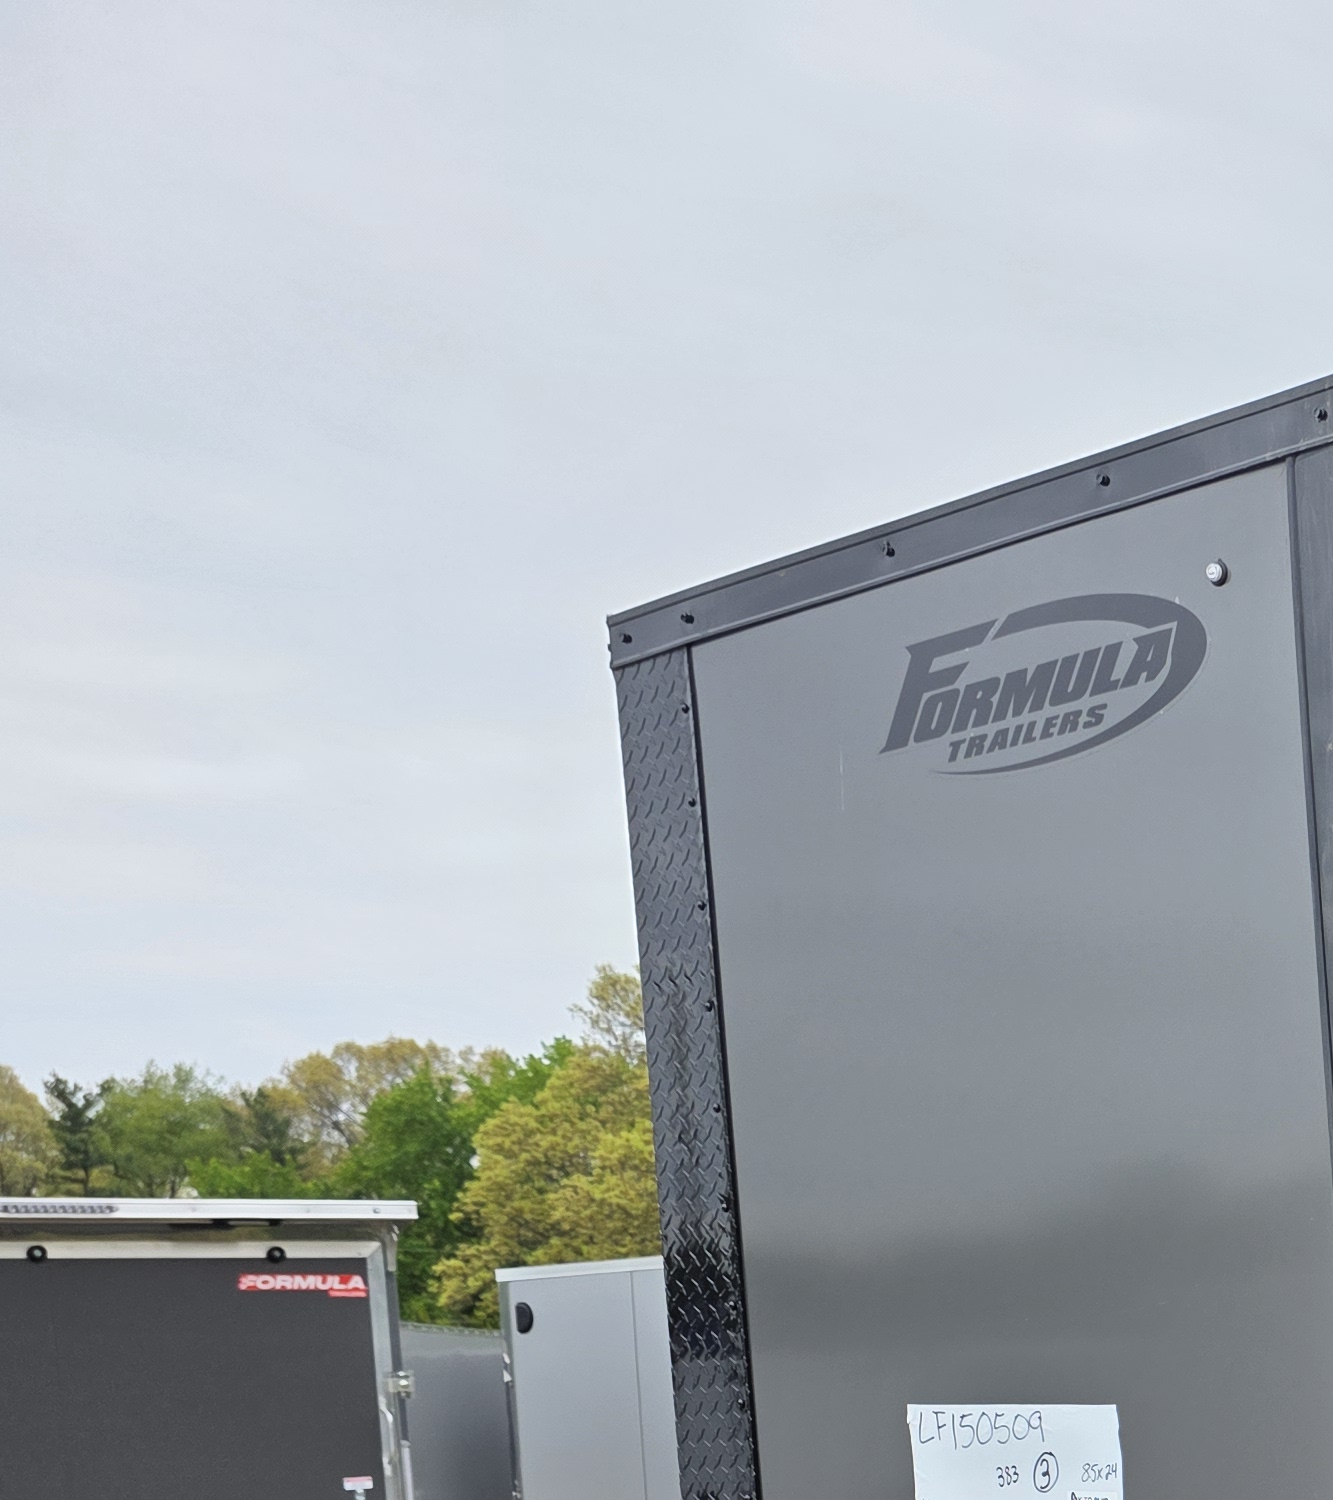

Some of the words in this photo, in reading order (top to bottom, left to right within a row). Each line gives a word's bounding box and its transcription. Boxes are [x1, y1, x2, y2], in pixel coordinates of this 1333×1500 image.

[878, 618, 1173, 754] FORMULA
[947, 703, 1108, 763] TRAILERS
[238, 1274, 366, 1291] FORMULA
[918, 1410, 1045, 1450] LF150509
